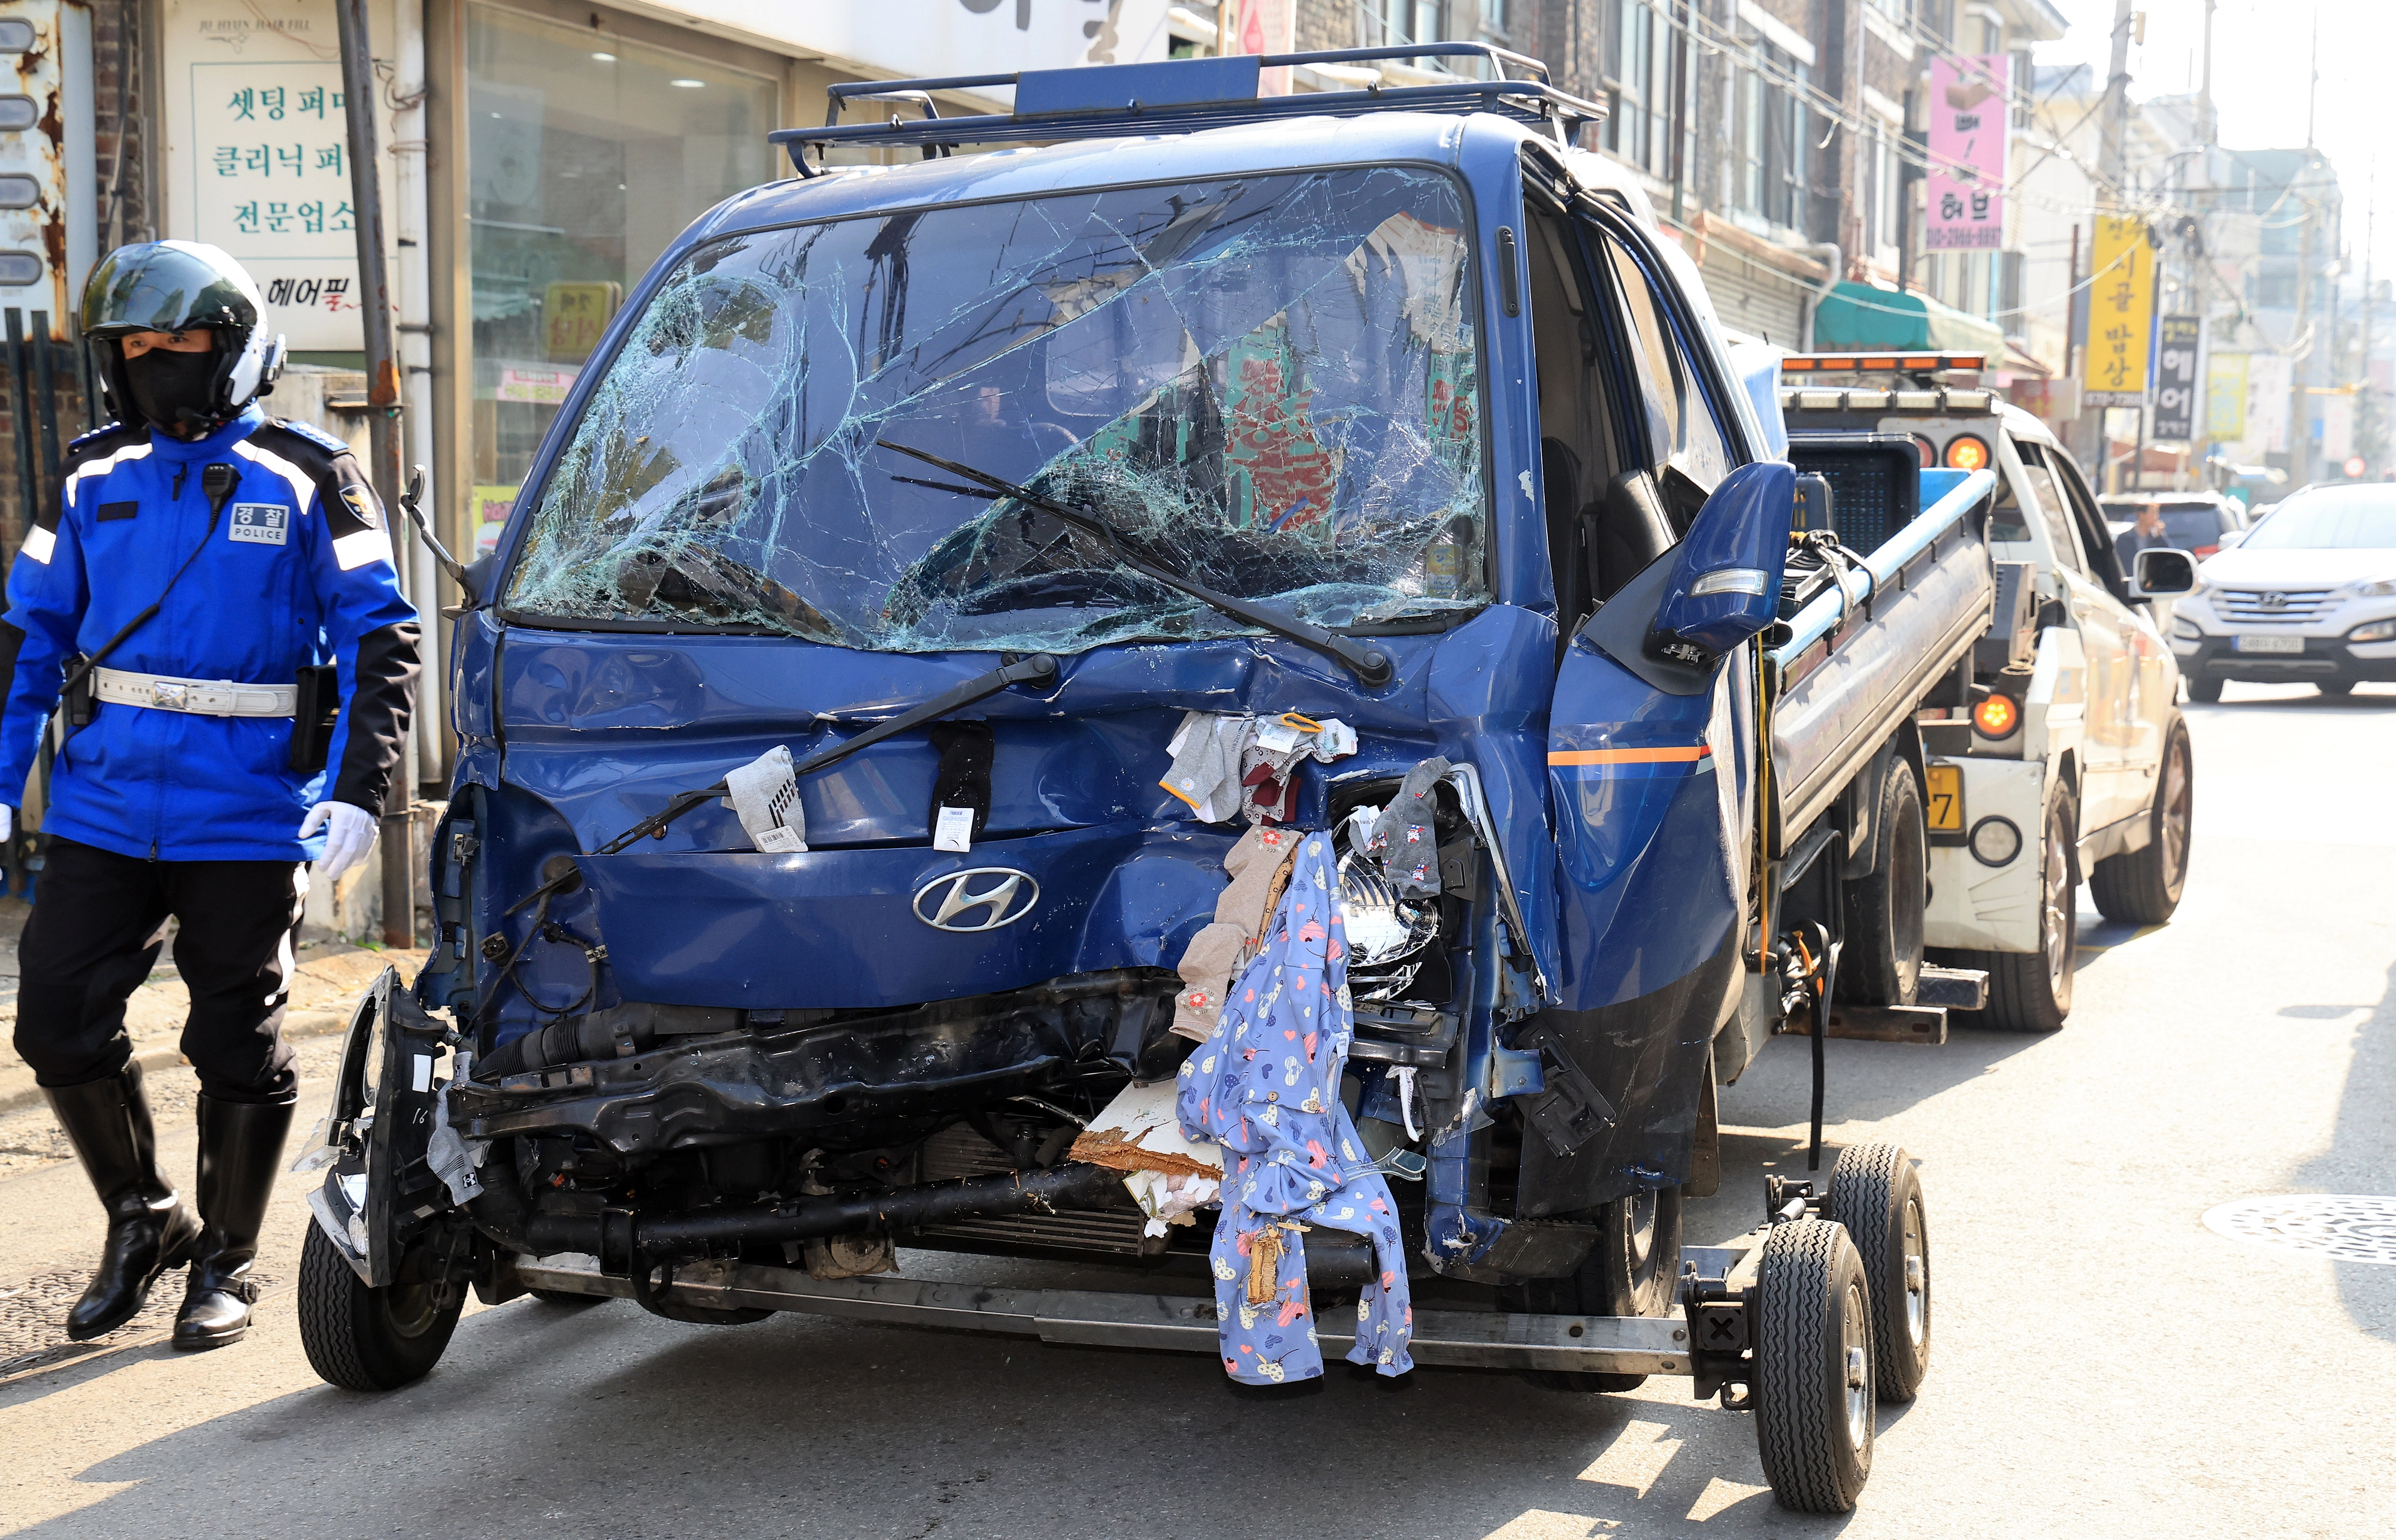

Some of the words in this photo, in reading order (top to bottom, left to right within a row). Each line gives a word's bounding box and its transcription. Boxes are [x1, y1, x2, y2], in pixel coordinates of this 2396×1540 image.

[227, 86, 285, 121] 셋팅
[213, 143, 302, 177] 클리닉
[234, 200, 356, 234] 전문업소
[237, 507, 283, 527] 경찰
[235, 528, 281, 539] POLICE
[1933, 794, 1953, 825] 7
[412, 1108, 429, 1124] 16
